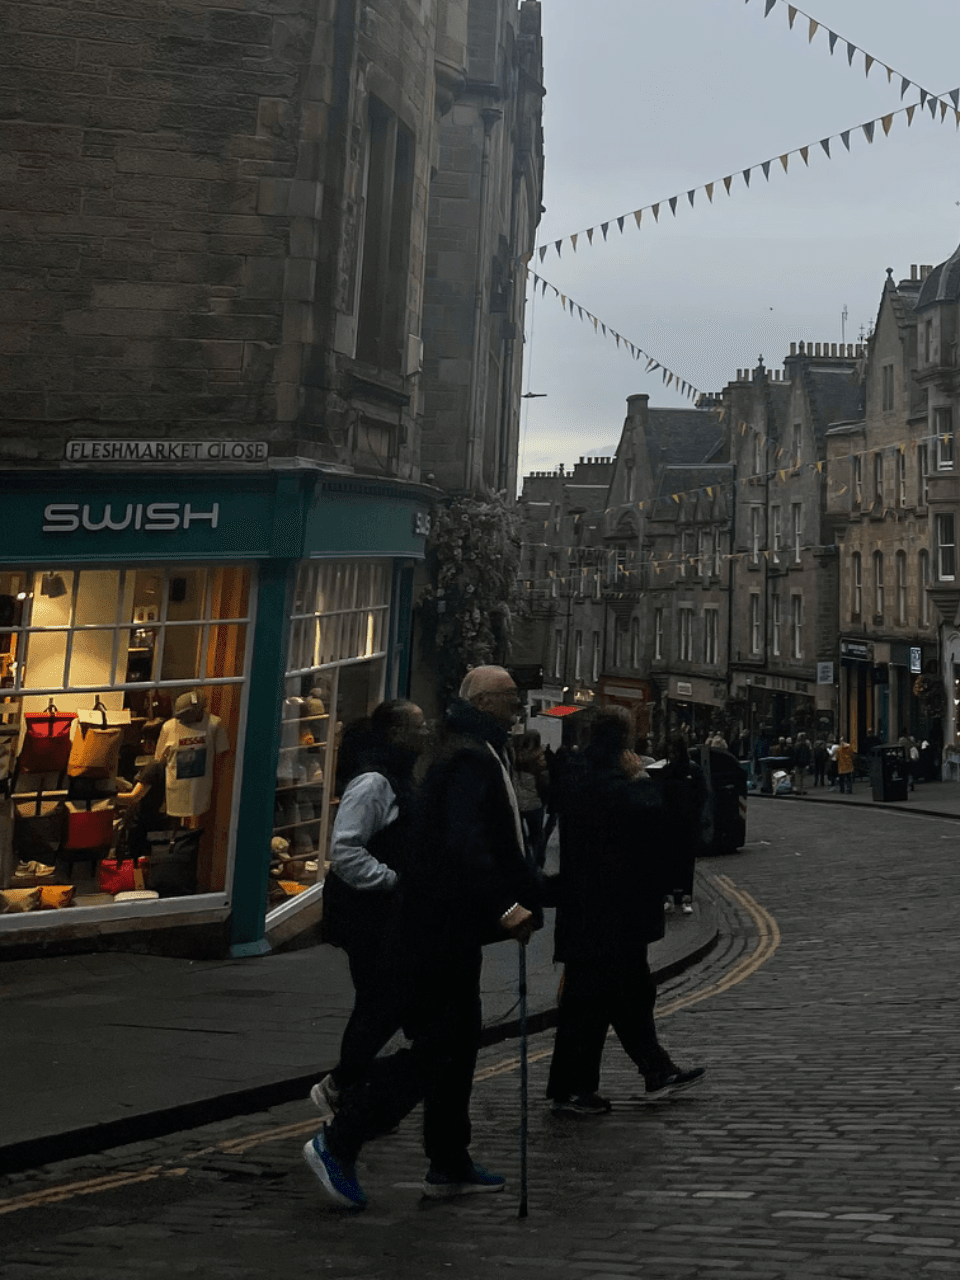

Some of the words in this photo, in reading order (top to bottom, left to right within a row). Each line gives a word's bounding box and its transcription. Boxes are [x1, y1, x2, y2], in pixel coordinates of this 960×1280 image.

[70, 442, 202, 459] FLESHMARKET
[207, 442, 265, 458] CLOSE
[42, 503, 219, 532] SWISH
